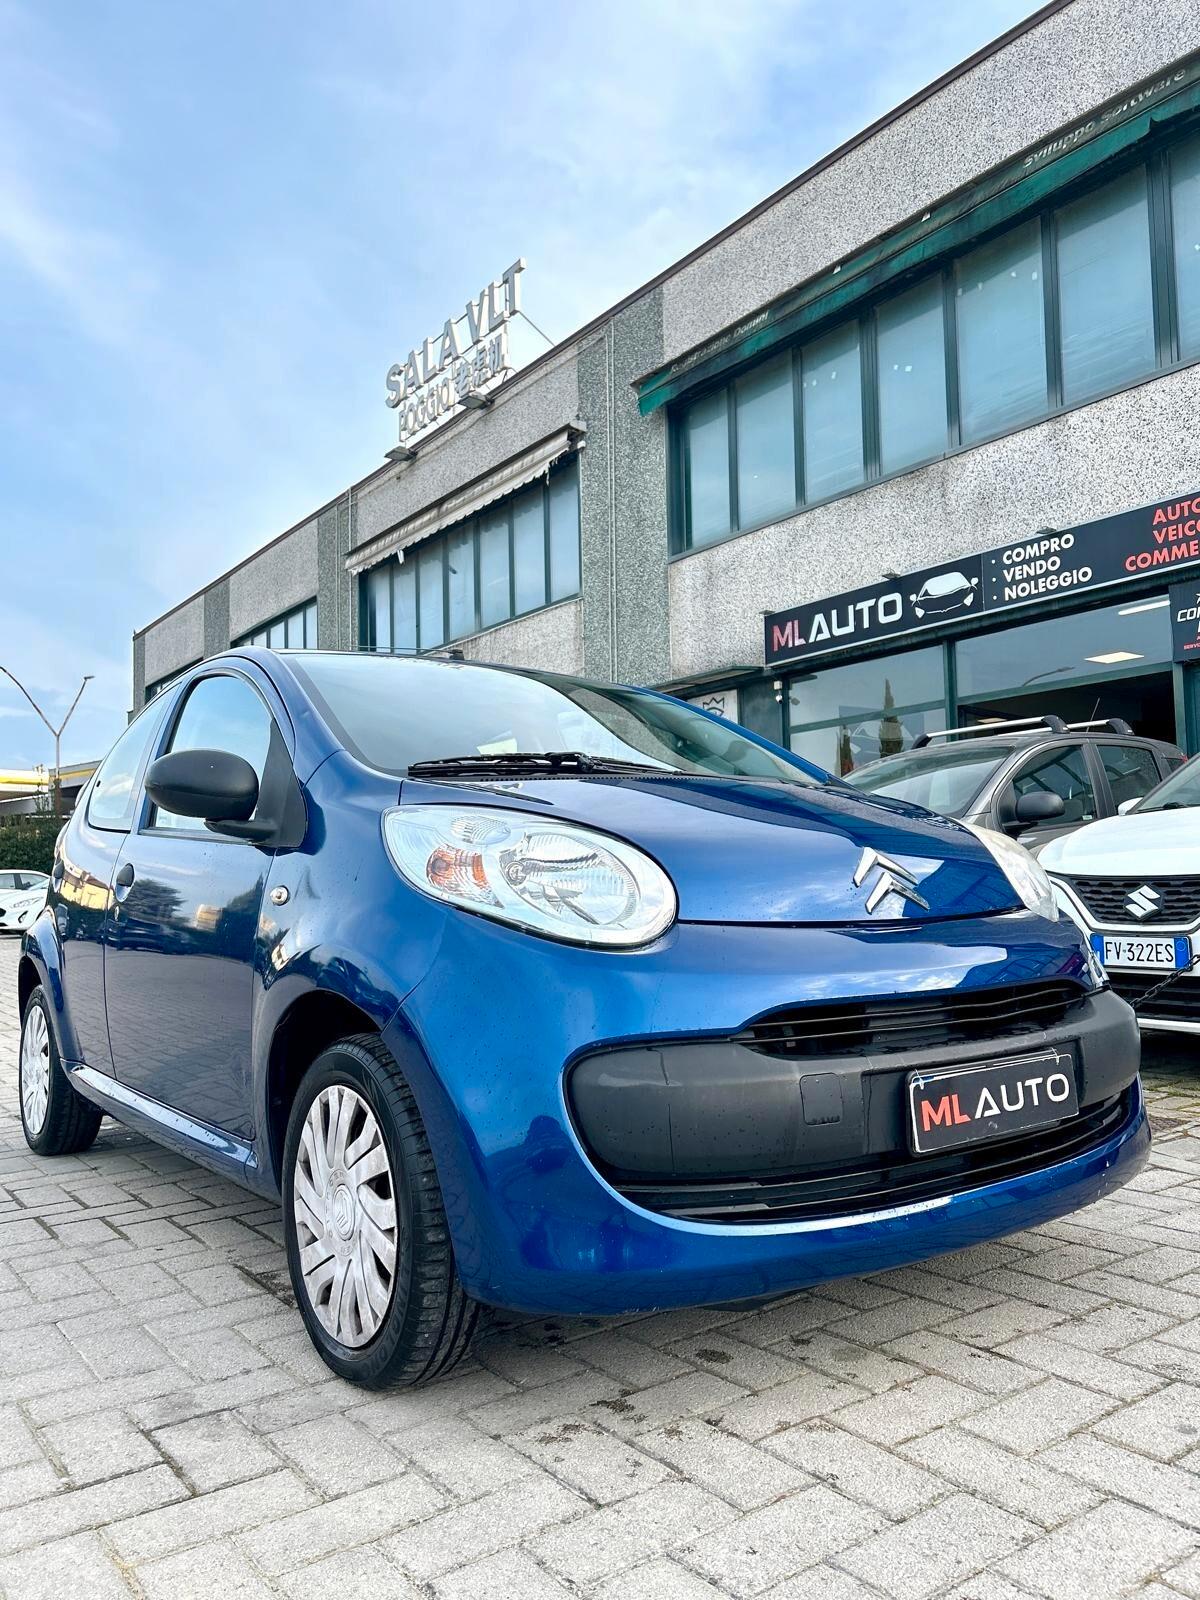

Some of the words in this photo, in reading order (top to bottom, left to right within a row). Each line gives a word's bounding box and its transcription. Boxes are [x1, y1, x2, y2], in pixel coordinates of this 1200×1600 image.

[386, 318, 462, 408] SALA
[465, 258, 526, 345] VLT
[1152, 519, 1200, 545] VEIC
[1002, 533, 1075, 565] COMPRO
[1002, 556, 1061, 583] VENDO
[1004, 566, 1093, 601] NOLEGGIO
[772, 619, 806, 652] ML
[808, 592, 903, 643] AUTO
[1127, 943, 1174, 962] 322ES
[921, 1093, 972, 1132] ML
[974, 1073, 1070, 1120] AUTO
